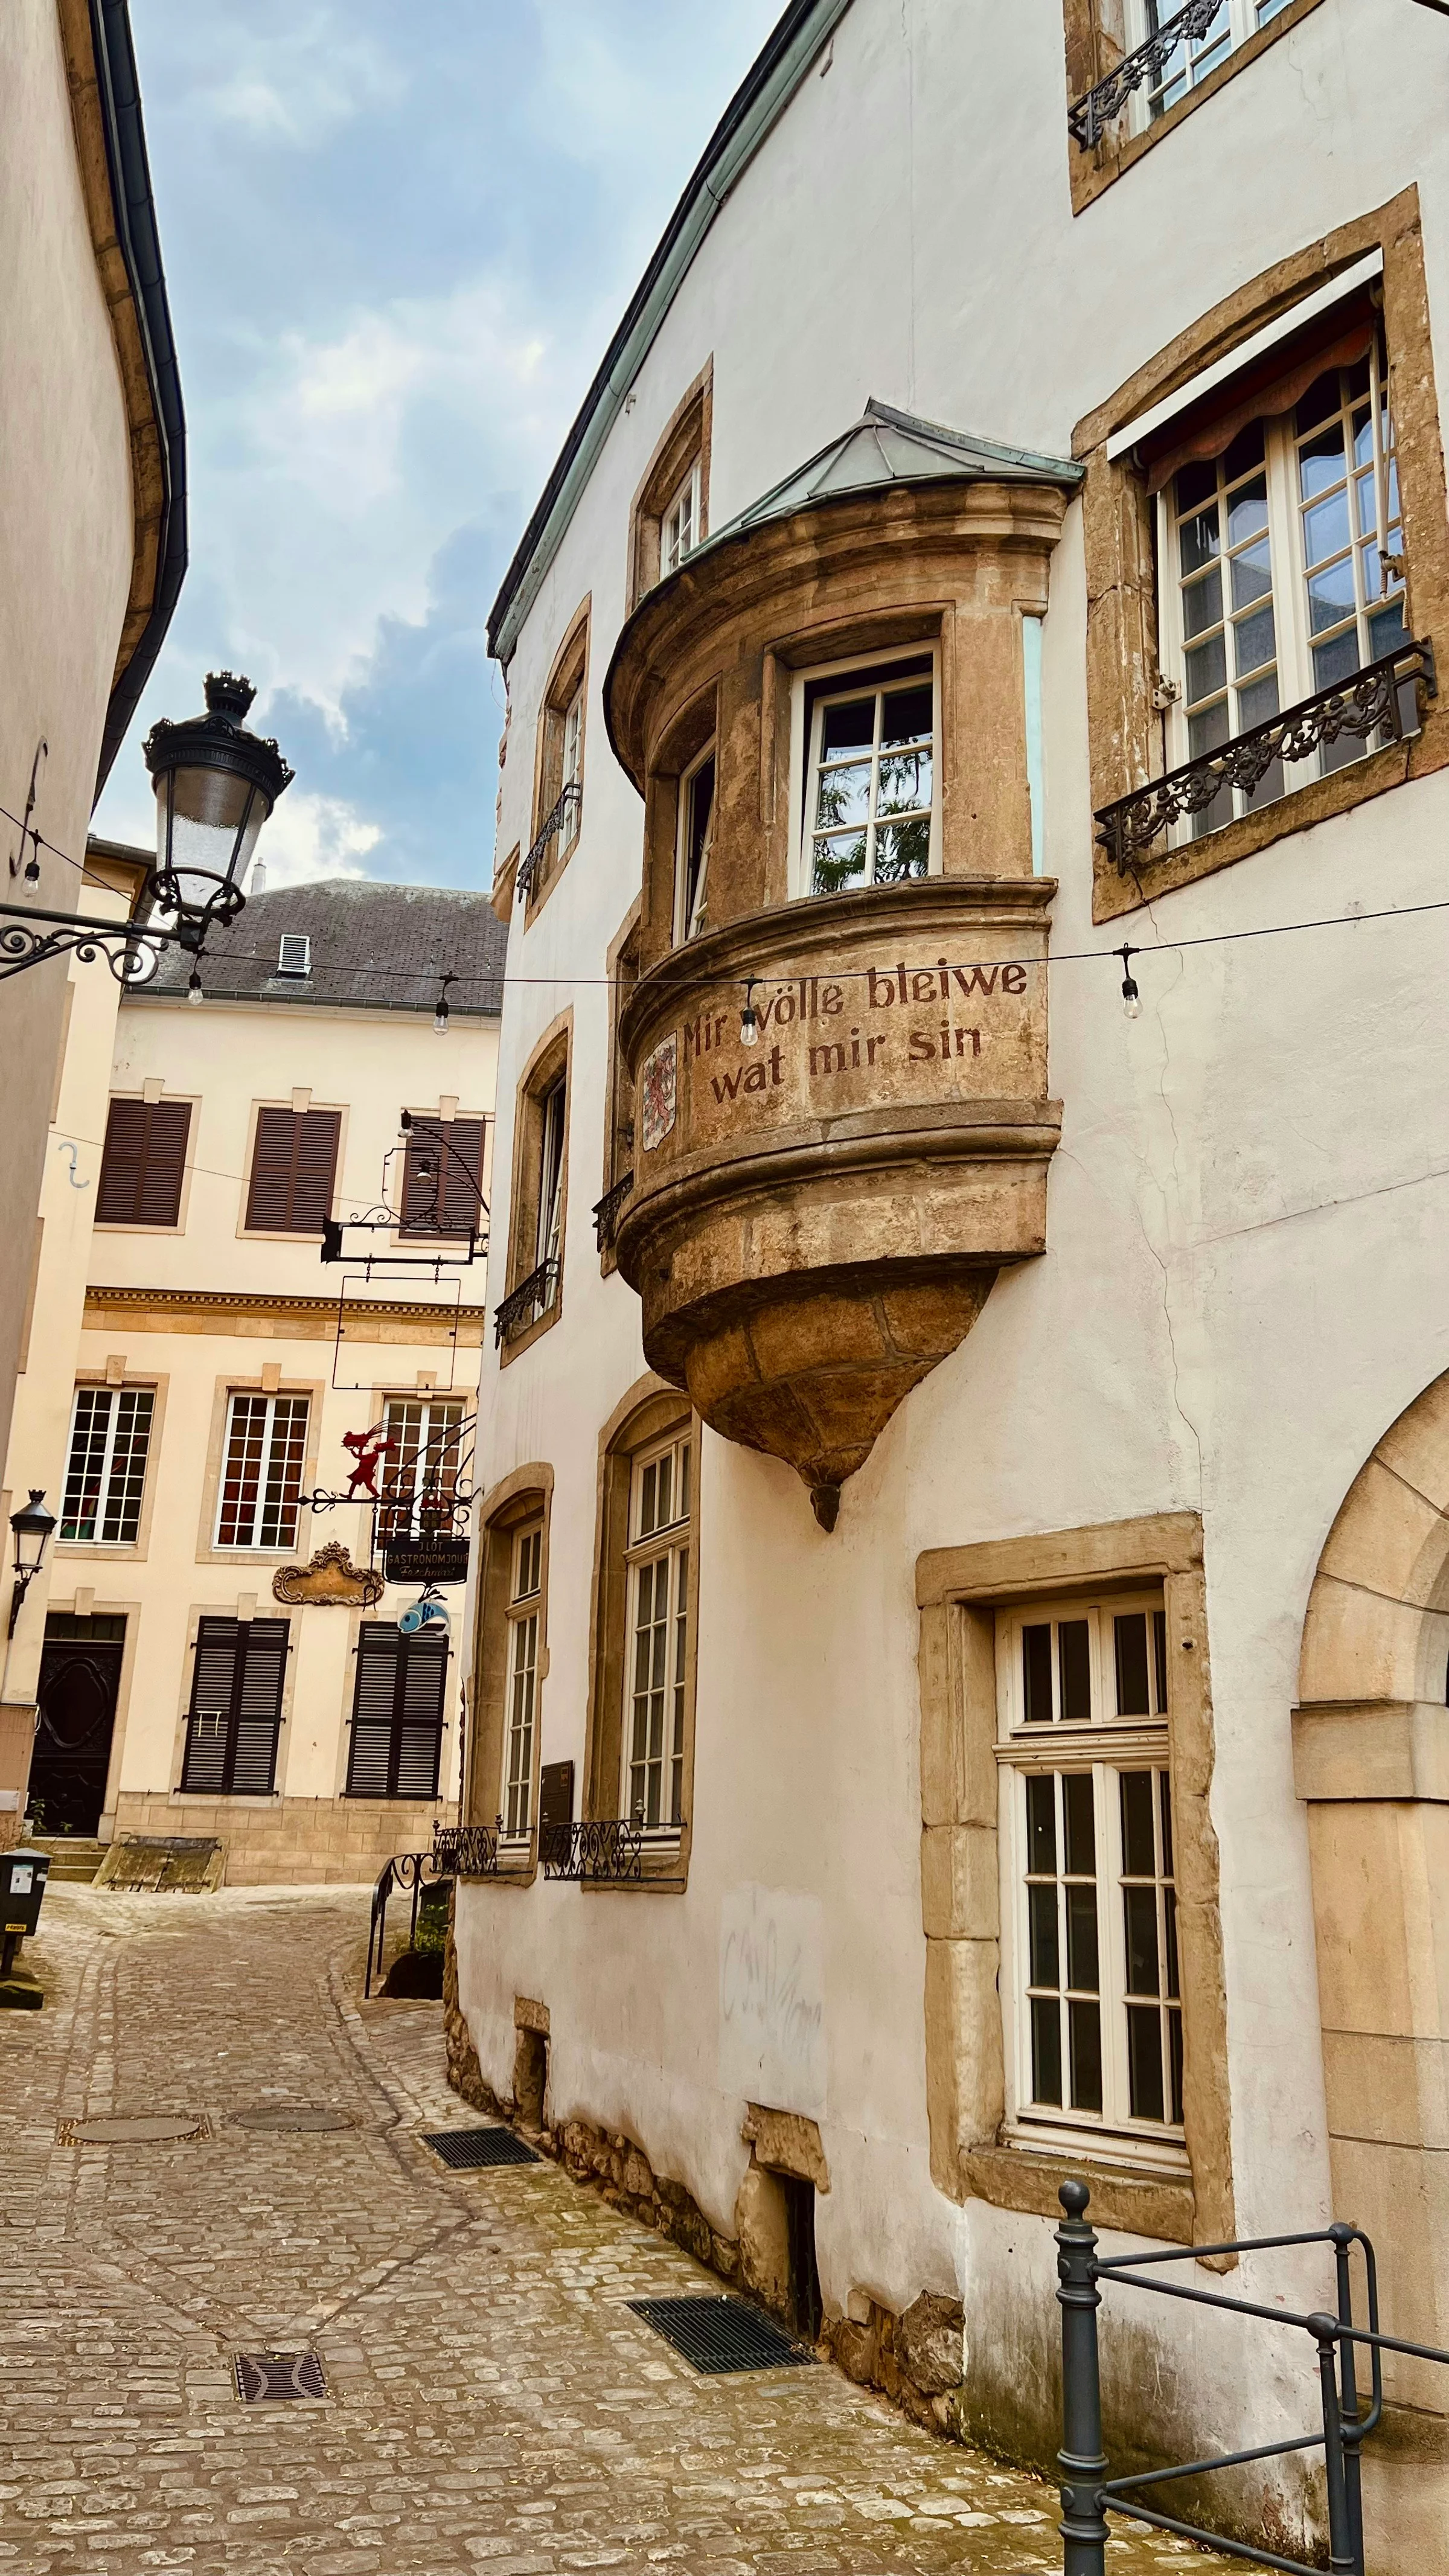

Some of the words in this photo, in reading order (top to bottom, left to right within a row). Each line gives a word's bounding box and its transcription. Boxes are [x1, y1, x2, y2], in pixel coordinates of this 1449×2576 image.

[683, 1013, 728, 1064] Mir
[869, 958, 1027, 1009] bleiwe
[710, 1045, 785, 1104] wat
[810, 1028, 886, 1076] mir
[909, 1020, 980, 1061] sin
